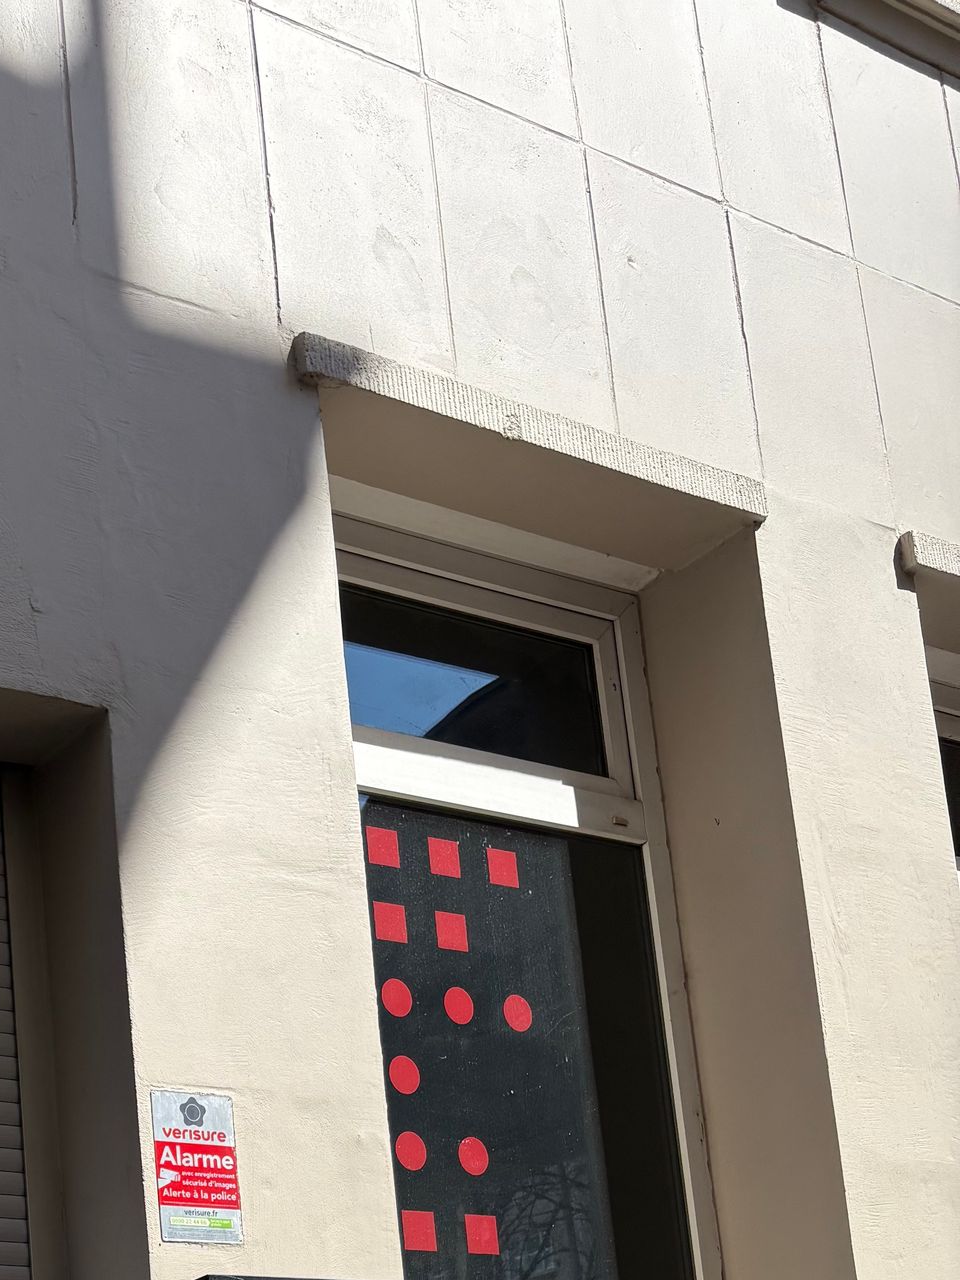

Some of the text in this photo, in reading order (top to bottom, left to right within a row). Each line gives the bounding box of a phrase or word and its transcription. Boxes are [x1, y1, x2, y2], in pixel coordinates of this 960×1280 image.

[162, 1127, 227, 1143] verisure
[160, 1145, 234, 1170] Alarme
[195, 1171, 235, 1180] enregistrement
[182, 1179, 207, 1187] sécurisé
[163, 1188, 191, 1199] Alerte
[193, 1190, 199, 1199] à
[200, 1189, 209, 1199] la
[184, 1208, 218, 1217] verisure.fr
